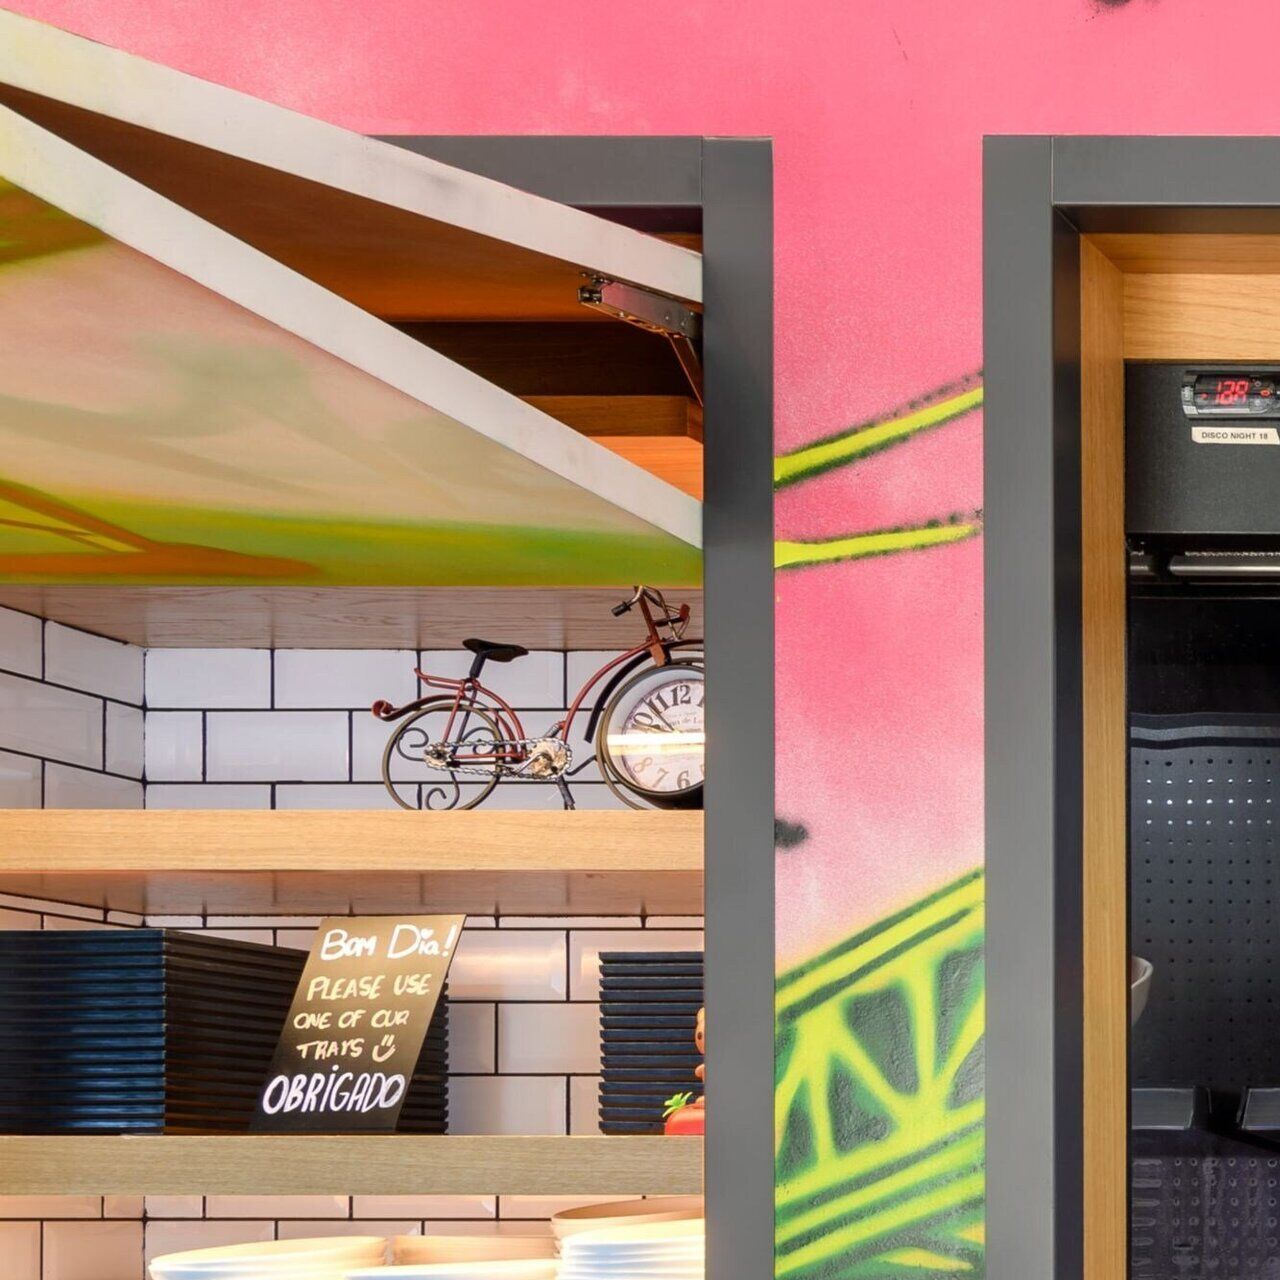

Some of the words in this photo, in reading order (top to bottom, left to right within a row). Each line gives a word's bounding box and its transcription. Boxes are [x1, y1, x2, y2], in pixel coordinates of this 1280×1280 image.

[1201, 431, 1229, 440] DISCO
[1230, 431, 1256, 440] NIGHT
[670, 684, 692, 707] 12
[387, 923, 458, 960] Dia!
[306, 974, 386, 1001] PLEASE
[393, 973, 432, 996] USE
[293, 1011, 332, 1030] ONE
[338, 1008, 366, 1029] OF
[370, 1009, 411, 1029] OUR
[295, 1037, 365, 1061] TRAYS
